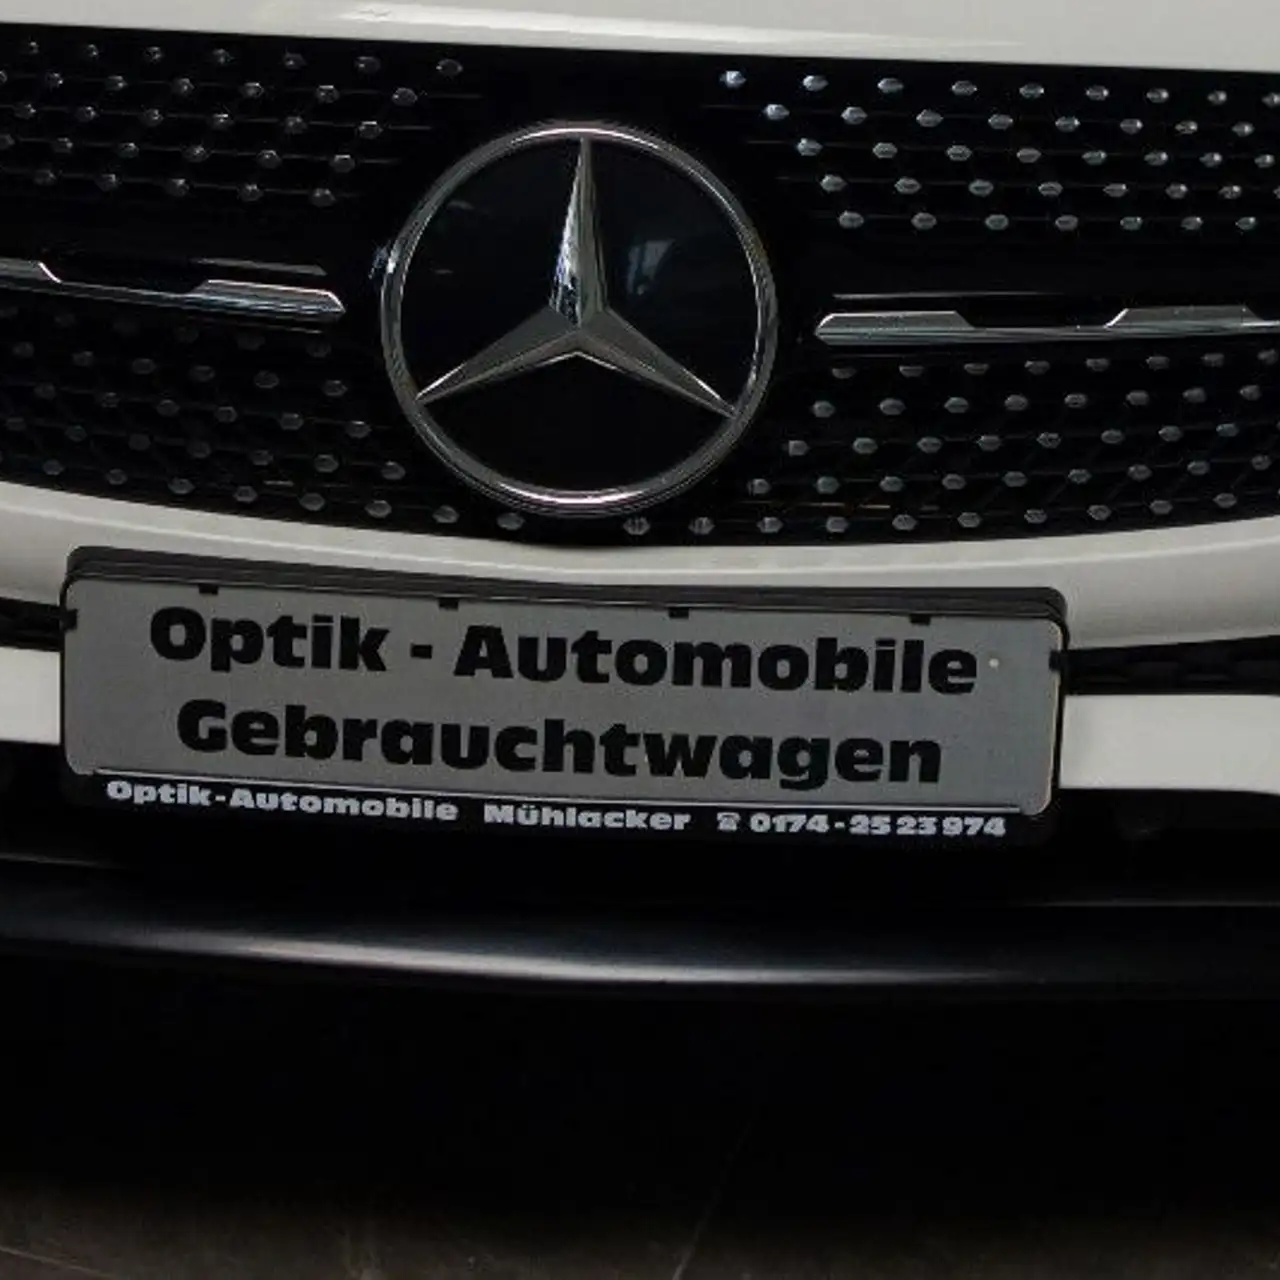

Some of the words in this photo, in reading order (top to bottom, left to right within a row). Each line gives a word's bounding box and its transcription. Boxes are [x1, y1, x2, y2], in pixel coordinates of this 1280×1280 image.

[150, 606, 390, 673] Optik
[453, 625, 978, 695] Automobile
[177, 699, 942, 791] Gebrauchtwagen
[106, 780, 459, 821] Optik-Automobile
[483, 803, 691, 830] Mühlacker
